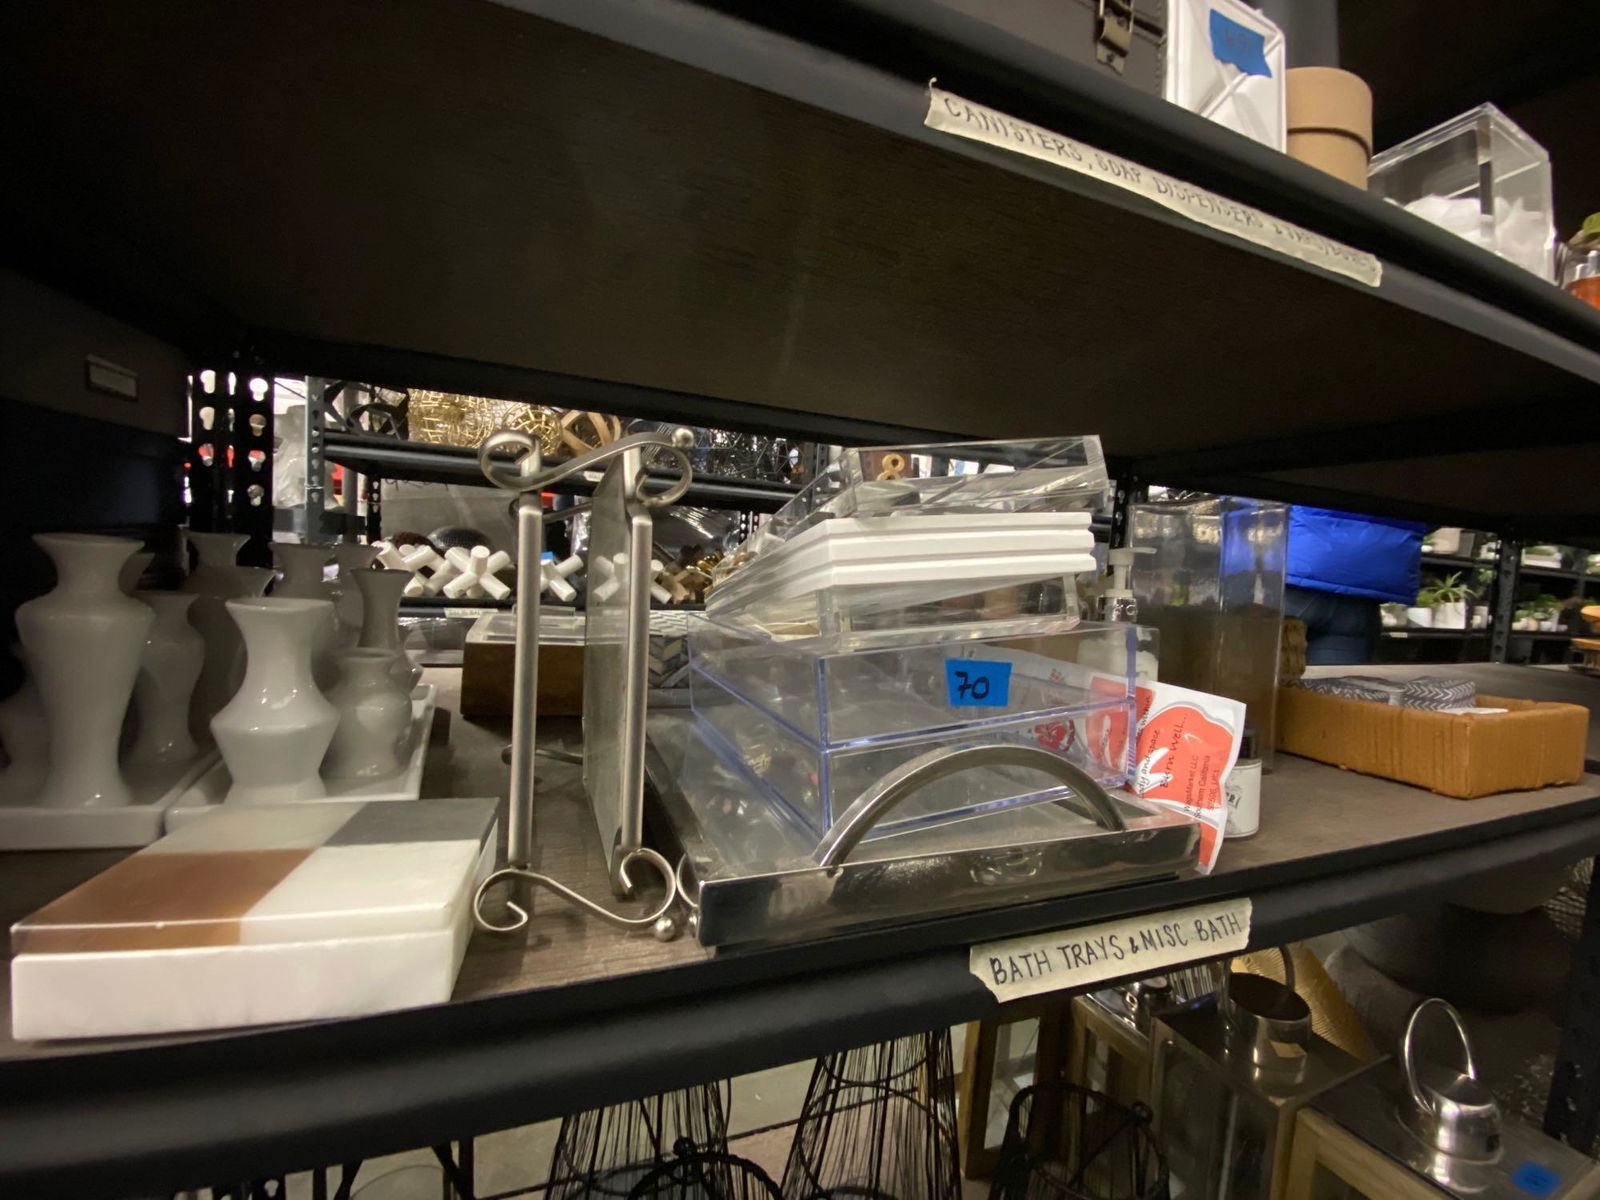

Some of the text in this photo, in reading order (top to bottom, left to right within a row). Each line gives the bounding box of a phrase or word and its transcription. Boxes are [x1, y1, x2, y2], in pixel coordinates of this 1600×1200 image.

[1094, 153, 1142, 184] SOAP
[954, 670, 990, 700] 70
[1148, 729, 1160, 753] space
[989, 949, 1052, 986] BATH
[1057, 934, 1125, 970] TRAYS
[1195, 912, 1243, 942] BATH
